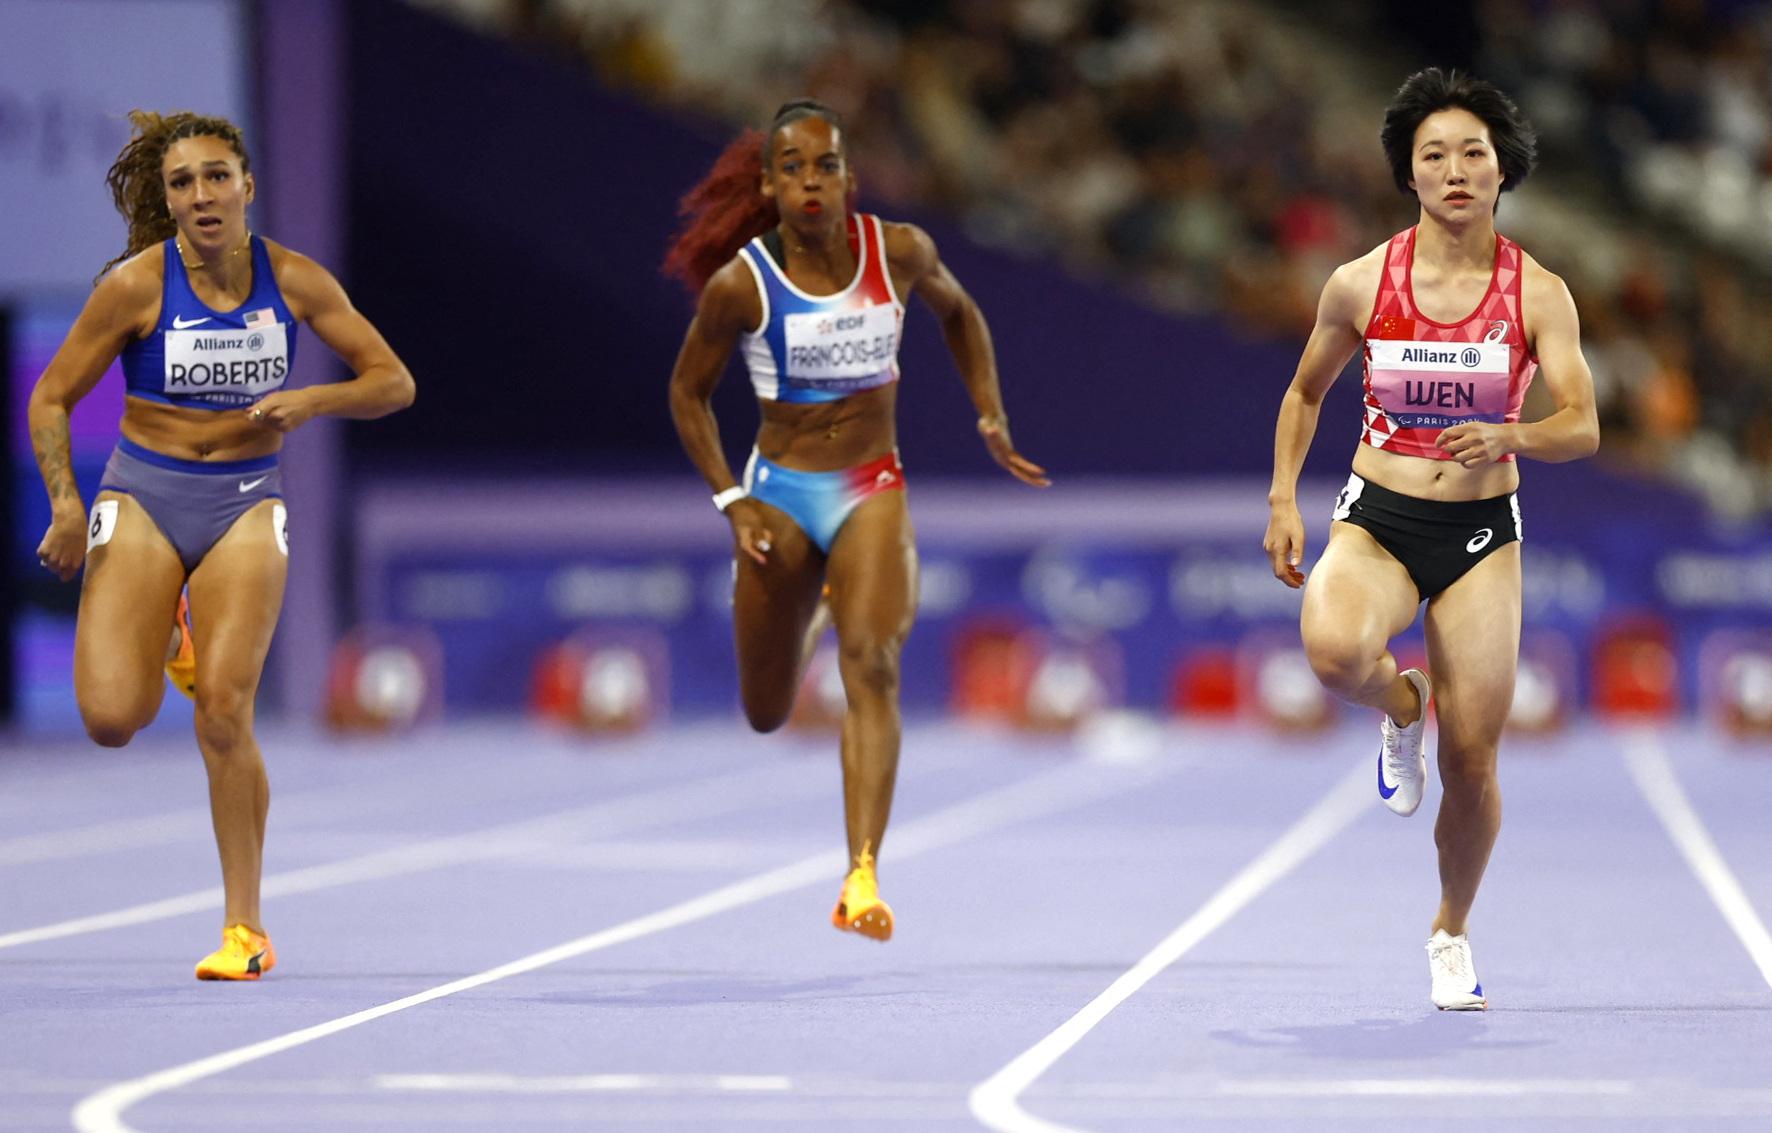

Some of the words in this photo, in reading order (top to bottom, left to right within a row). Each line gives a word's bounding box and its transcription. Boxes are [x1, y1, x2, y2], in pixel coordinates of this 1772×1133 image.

[193, 337, 243, 351] Allianz
[1401, 348, 1457, 364] Allianz
[170, 356, 286, 386] ROBERTS
[1405, 380, 1474, 409] WEN
[1416, 417, 1449, 426] PARIS
[91, 512, 102, 538] 6
